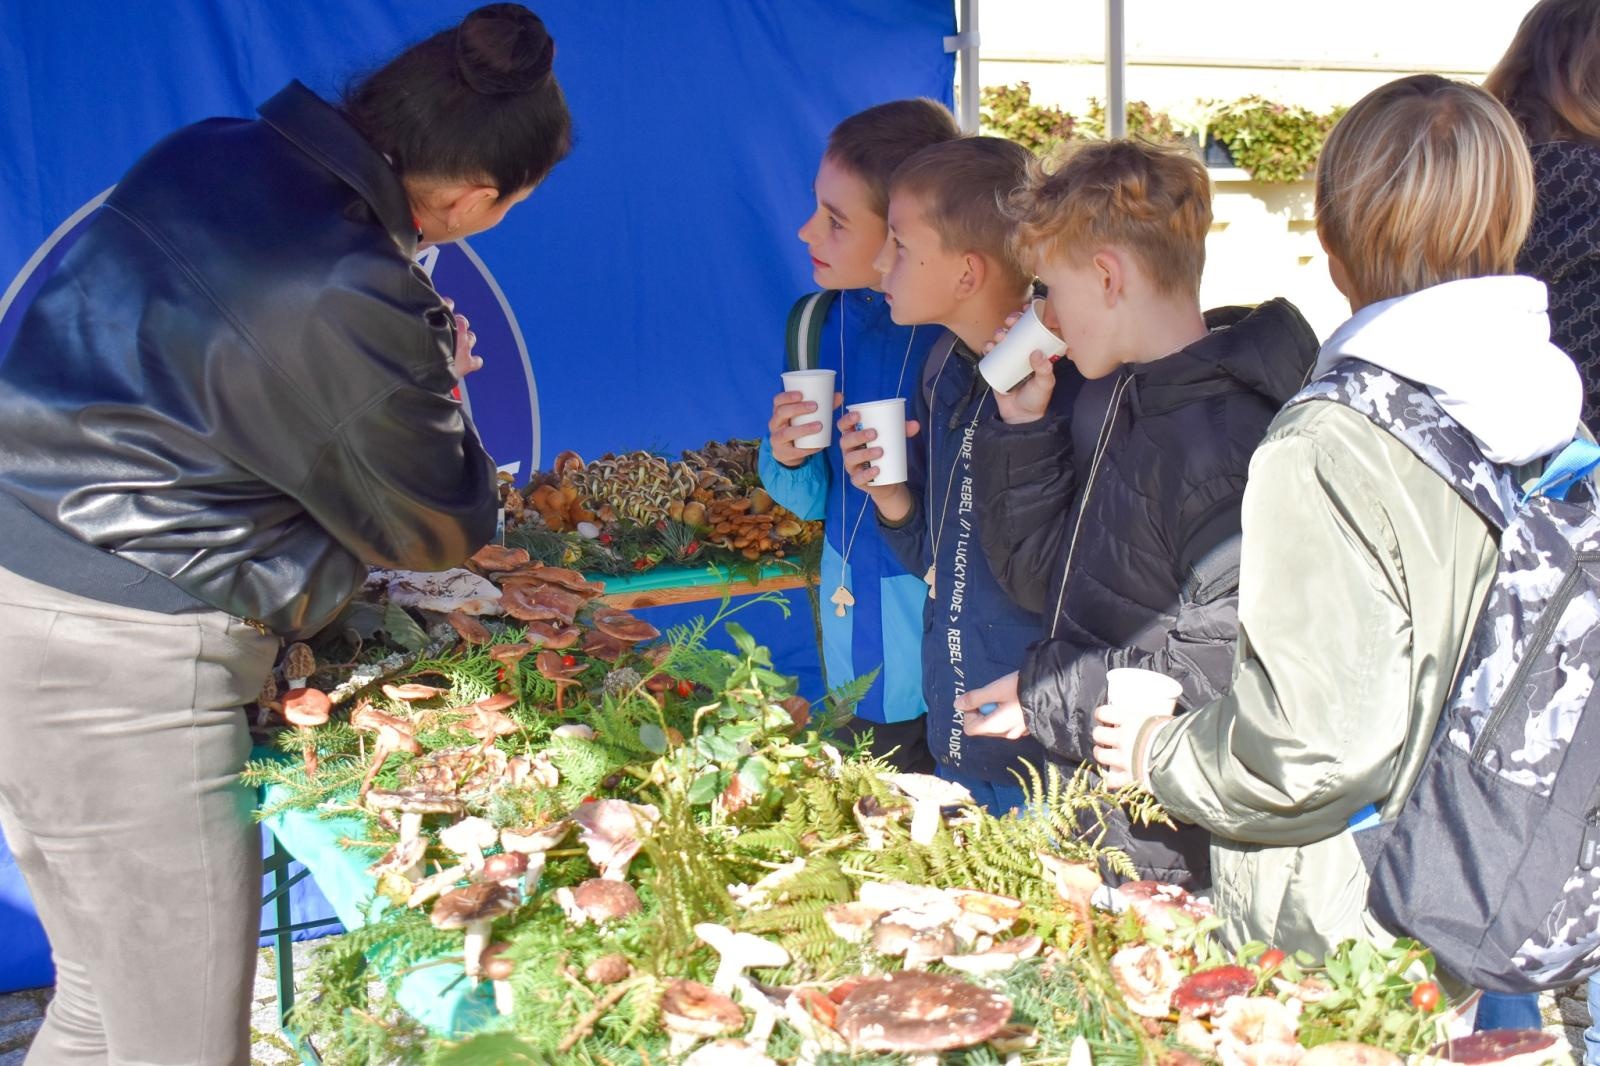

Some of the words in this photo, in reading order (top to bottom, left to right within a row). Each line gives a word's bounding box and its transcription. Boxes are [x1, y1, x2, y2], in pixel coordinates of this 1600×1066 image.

[959, 476, 972, 515] REBEL
[948, 628, 962, 664] REBEL
[953, 688, 965, 726] LKY
[949, 729, 962, 760] DUDE
